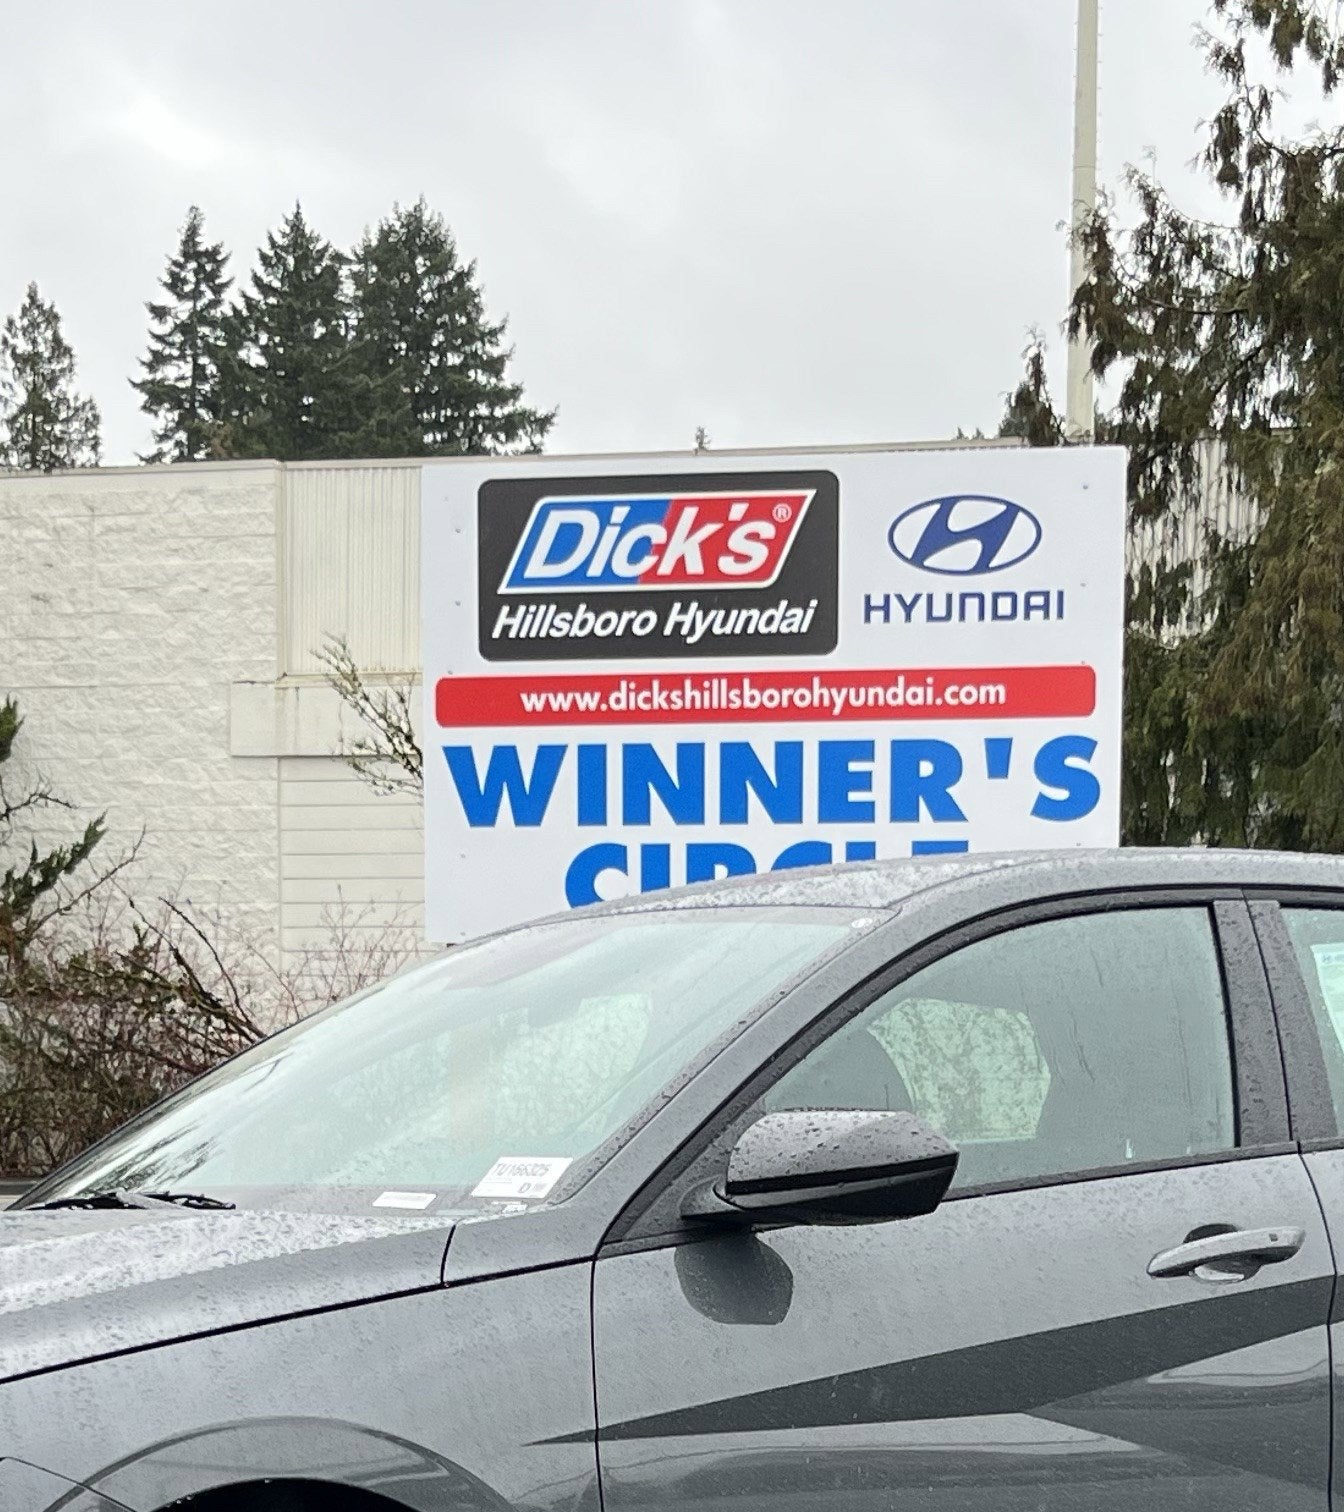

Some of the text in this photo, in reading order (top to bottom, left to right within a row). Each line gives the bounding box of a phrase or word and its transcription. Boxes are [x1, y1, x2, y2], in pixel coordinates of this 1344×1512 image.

[492, 599, 819, 645] Hillsboro Hyundai
[863, 589, 1065, 625] HYUNDAI
[520, 676, 1006, 718] www.dickshillsborohyundai.com
[442, 734, 1101, 828] WINNER'S
